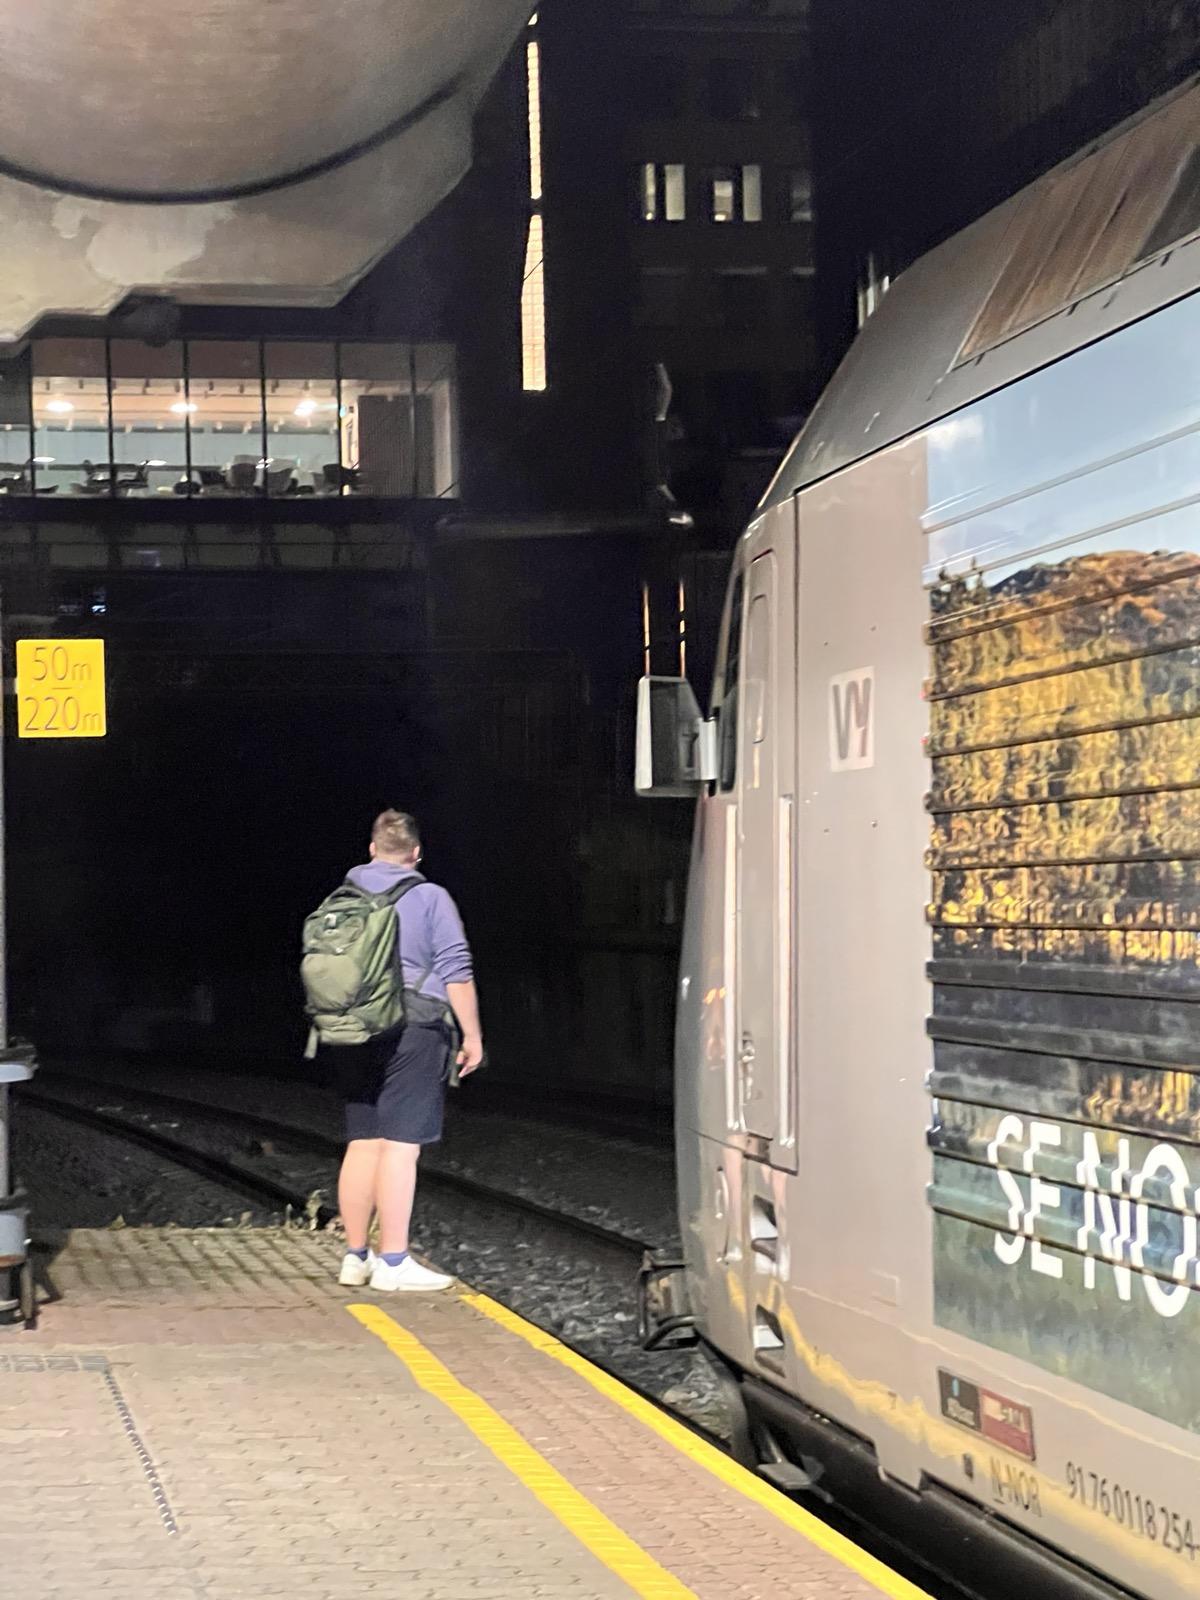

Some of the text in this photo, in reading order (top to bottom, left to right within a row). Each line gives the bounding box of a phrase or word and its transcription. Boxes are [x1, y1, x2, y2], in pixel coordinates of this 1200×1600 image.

[32, 646, 92, 681] 50m
[25, 696, 101, 731] 220m
[1076, 1131, 1200, 1318] NO
